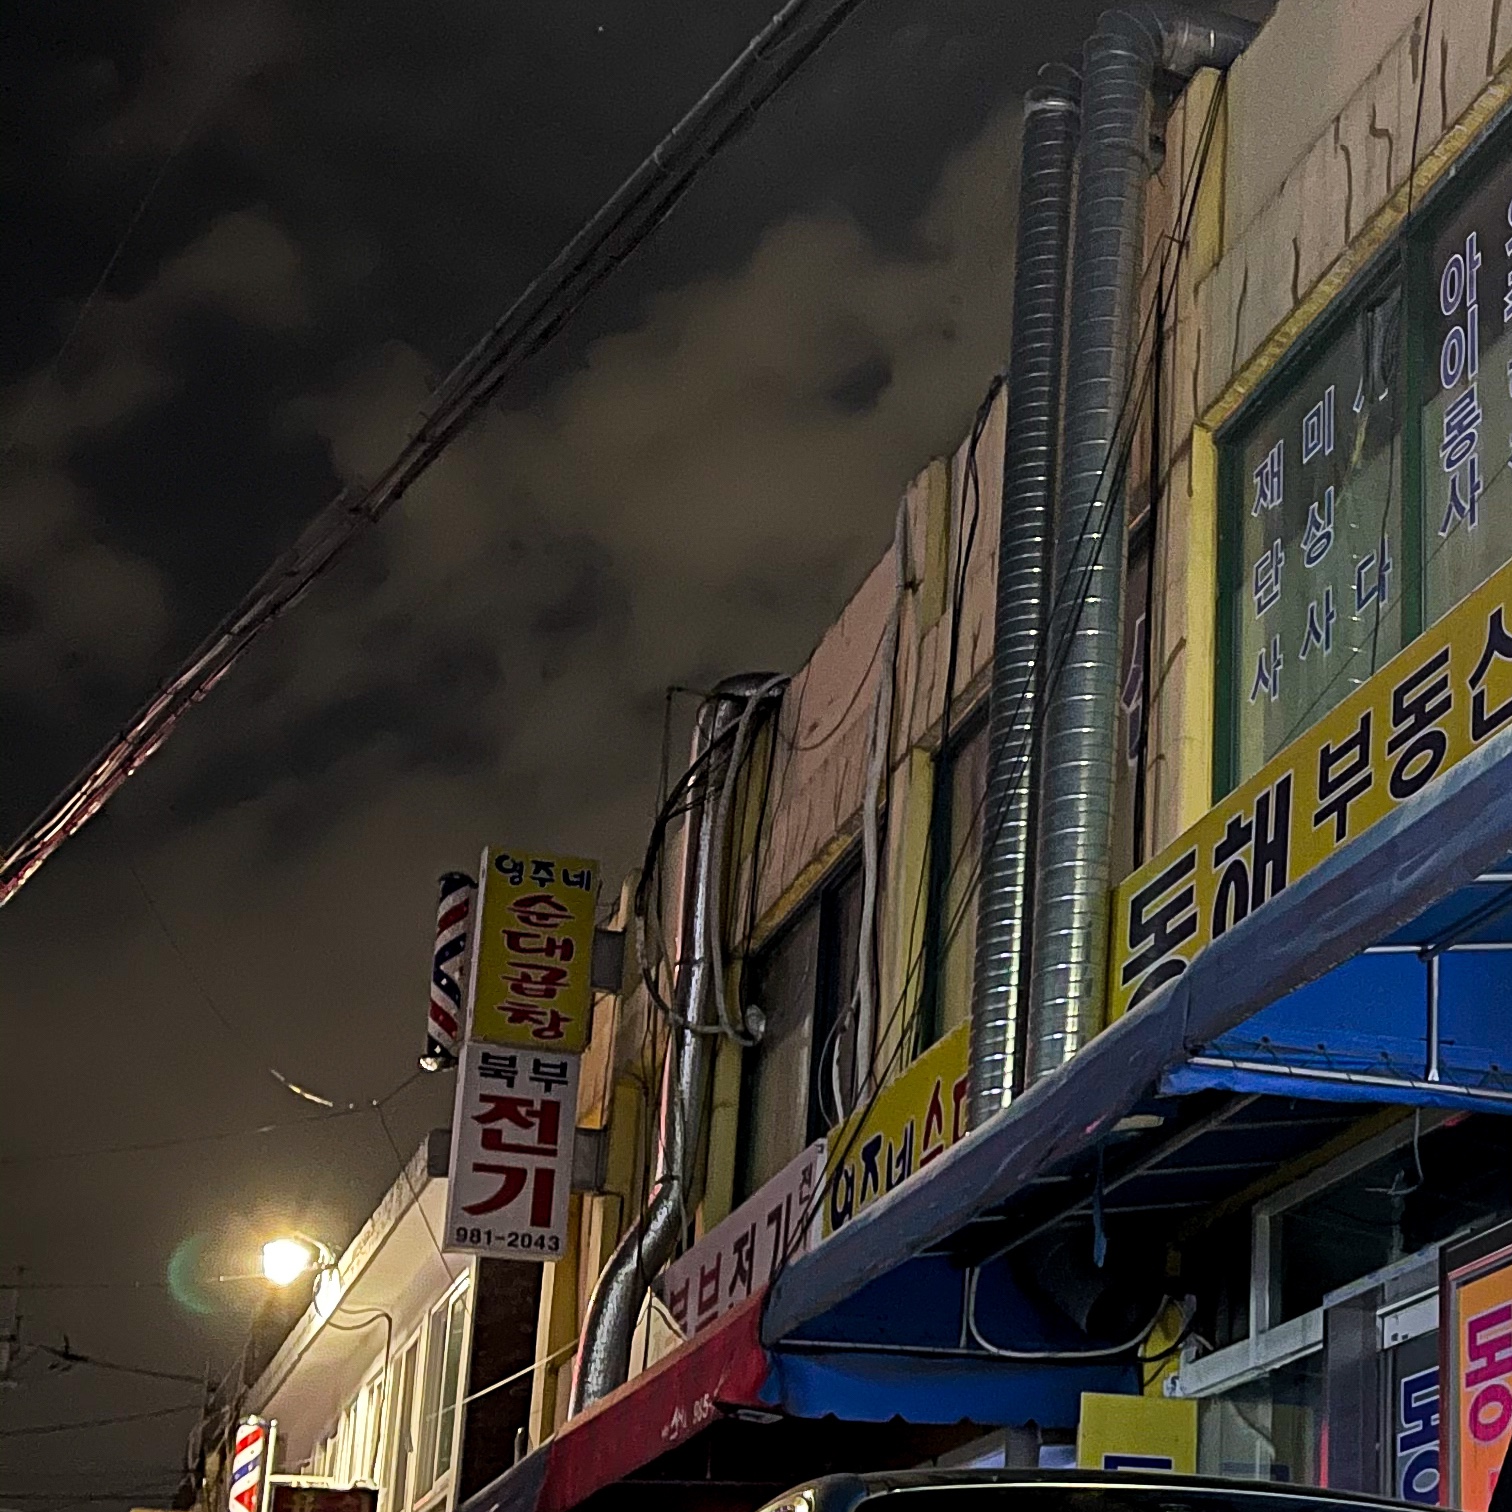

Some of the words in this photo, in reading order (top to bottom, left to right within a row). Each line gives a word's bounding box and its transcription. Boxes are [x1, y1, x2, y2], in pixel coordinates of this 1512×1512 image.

[1438, 231, 1482, 536] 아이롱사
[1250, 438, 1285, 705] 재단사
[1299, 384, 1336, 661] 미싱사
[494, 854, 592, 892] 영주네
[495, 894, 575, 1040] 순대곱창
[477, 1052, 569, 1093] 북부
[461, 1092, 561, 1229] 전기
[455, 1226, 560, 1251] 981-2043
